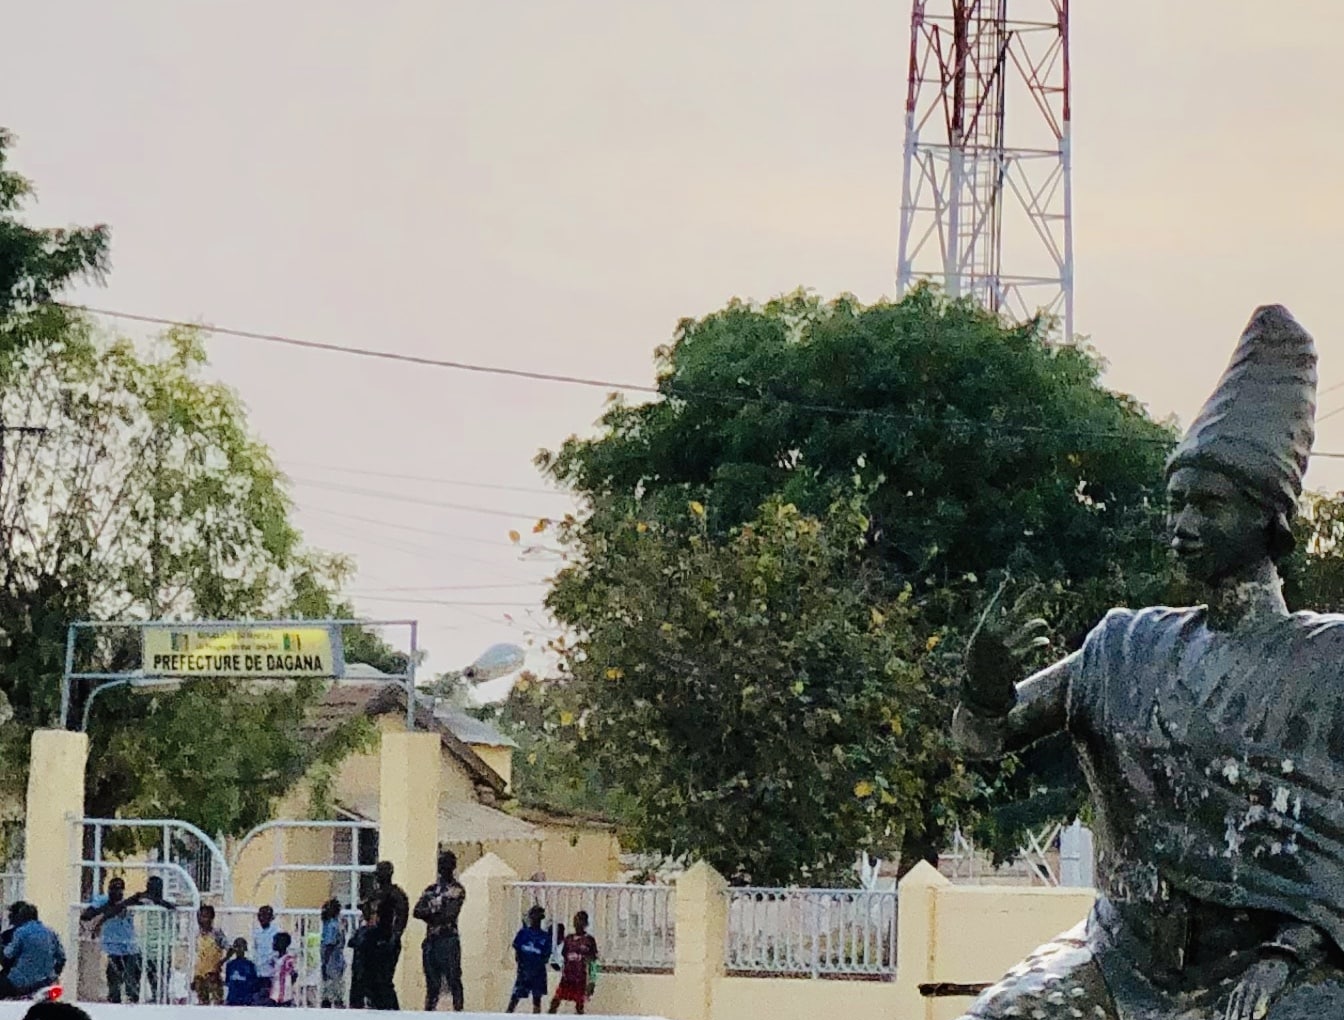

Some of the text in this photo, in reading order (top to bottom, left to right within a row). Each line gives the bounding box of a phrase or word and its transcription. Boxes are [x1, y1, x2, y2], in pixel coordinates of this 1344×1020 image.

[154, 654, 323, 671] PREFECTURE DE DAGANA
